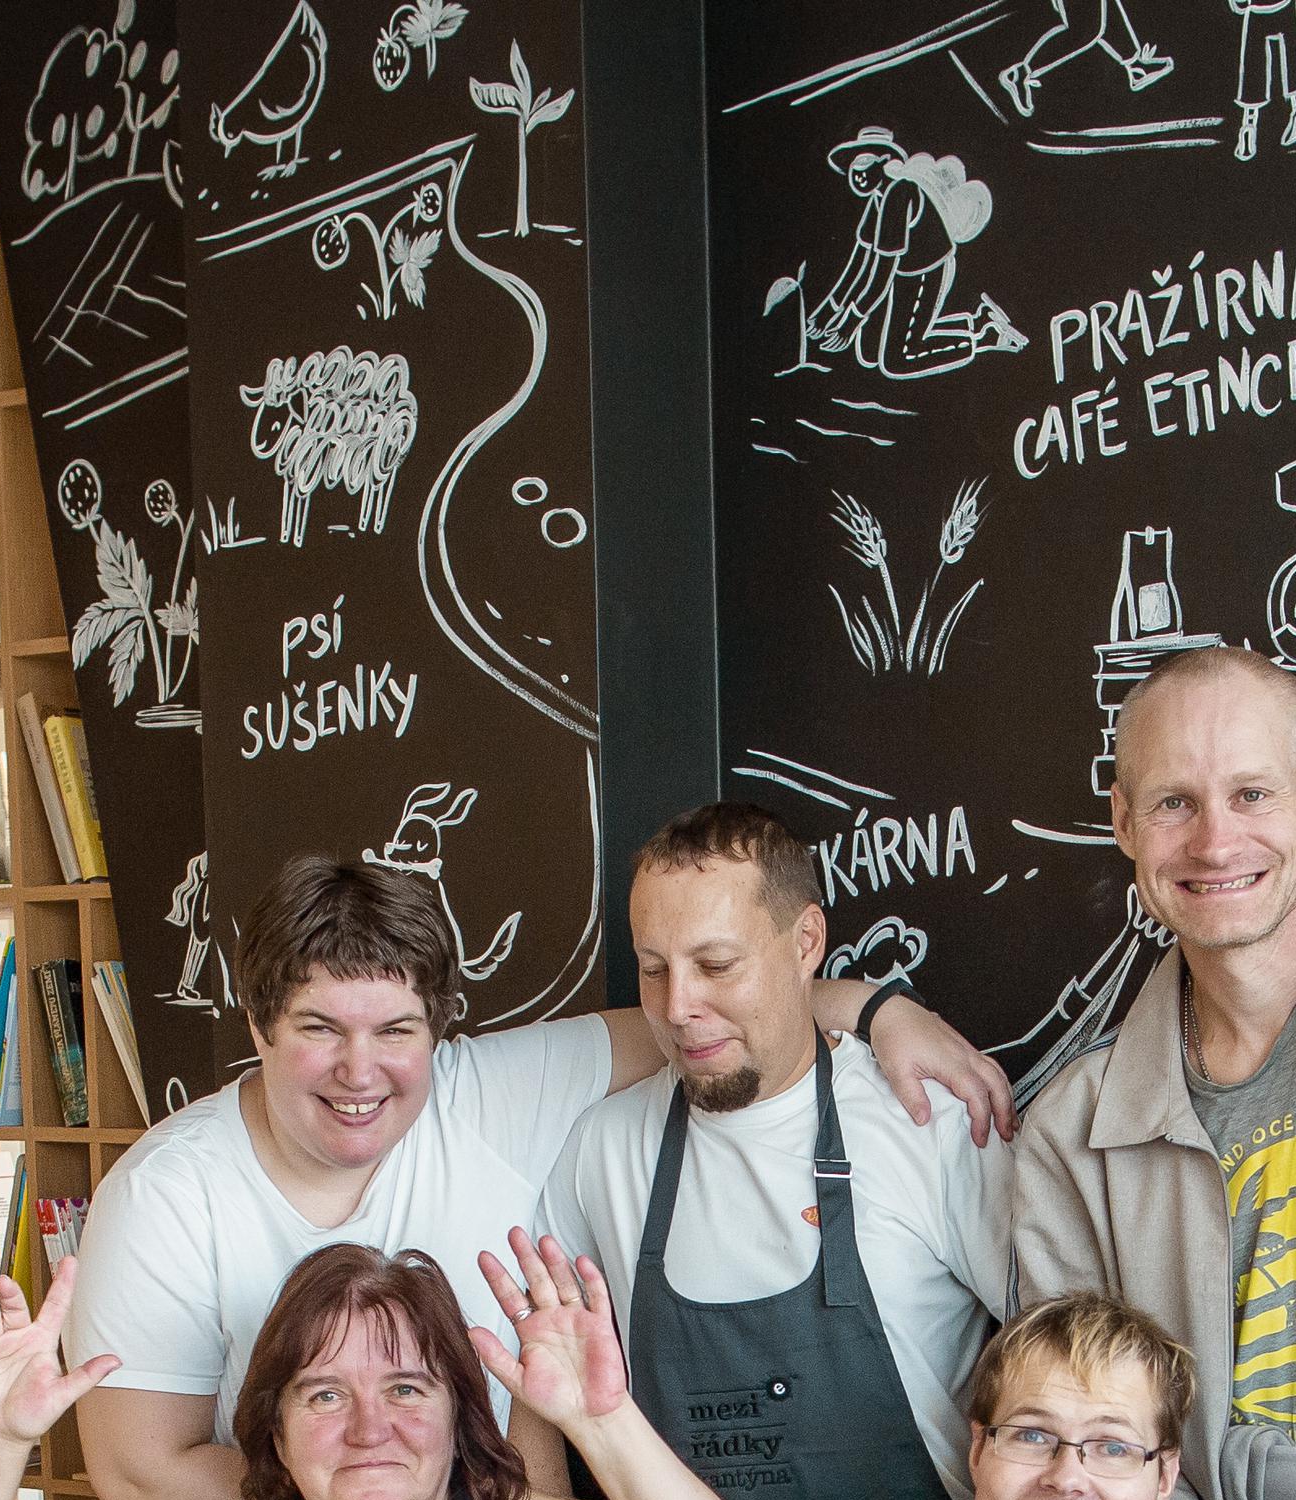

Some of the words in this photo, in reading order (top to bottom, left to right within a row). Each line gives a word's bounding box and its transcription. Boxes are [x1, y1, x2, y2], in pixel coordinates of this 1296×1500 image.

[1013, 378, 1128, 480] CAFÉ
[241, 660, 418, 760] SUŠENKY
[809, 806, 977, 908] KÁRNA
[1219, 1142, 1245, 1174] ND
[688, 1393, 761, 1422] mezi
[690, 1433, 785, 1460] řádky
[706, 1467, 792, 1491] antýna
